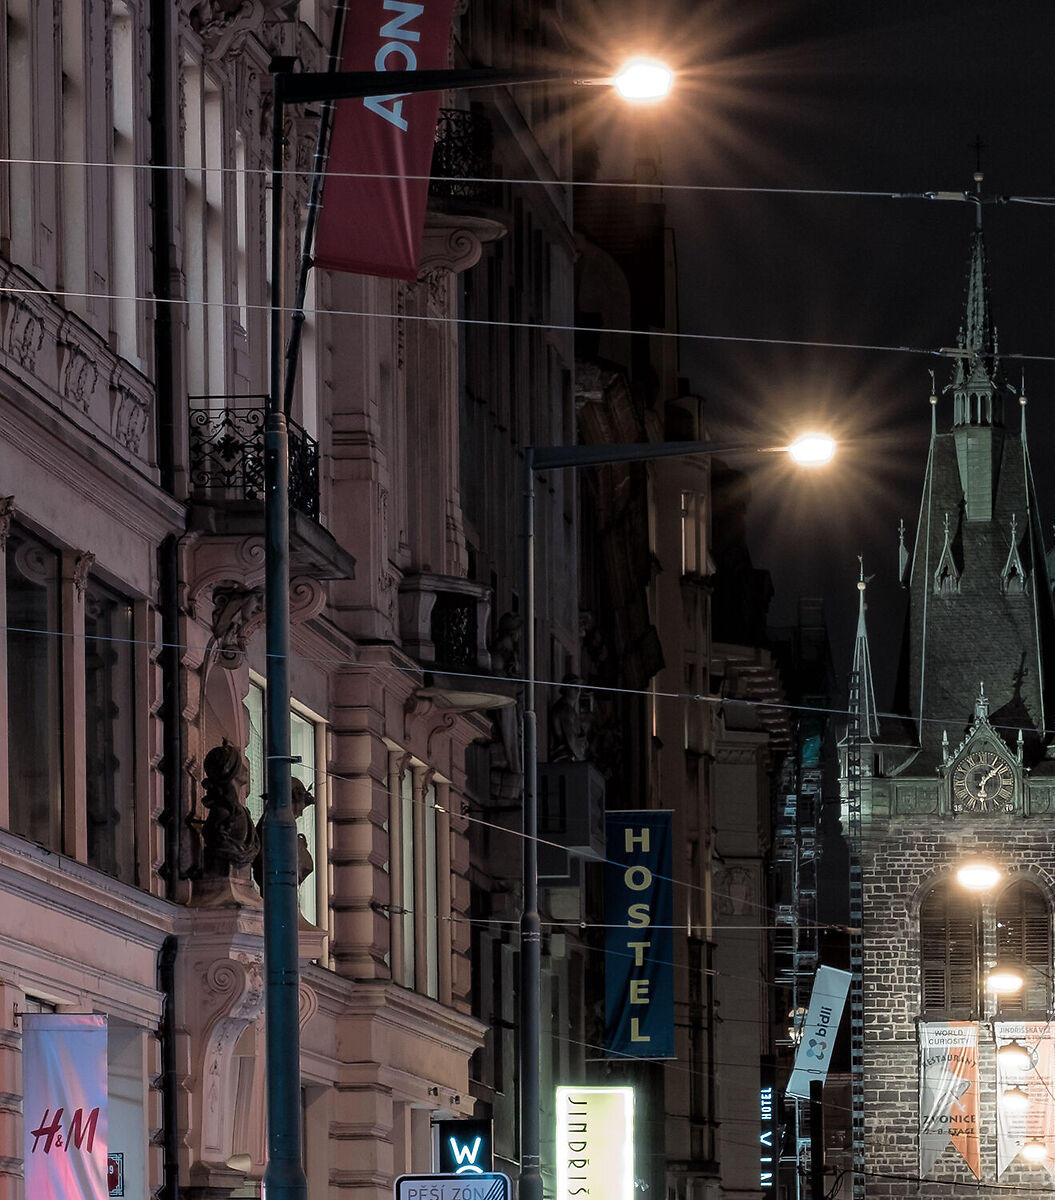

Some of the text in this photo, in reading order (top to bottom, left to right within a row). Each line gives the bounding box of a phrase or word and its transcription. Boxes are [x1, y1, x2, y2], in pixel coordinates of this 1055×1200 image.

[363, 0, 425, 132] AON
[624, 828, 652, 1042] HOSTEL
[816, 1006, 833, 1038] bidli
[760, 1087, 772, 1120] HOTEL
[31, 1107, 100, 1154] H&M
